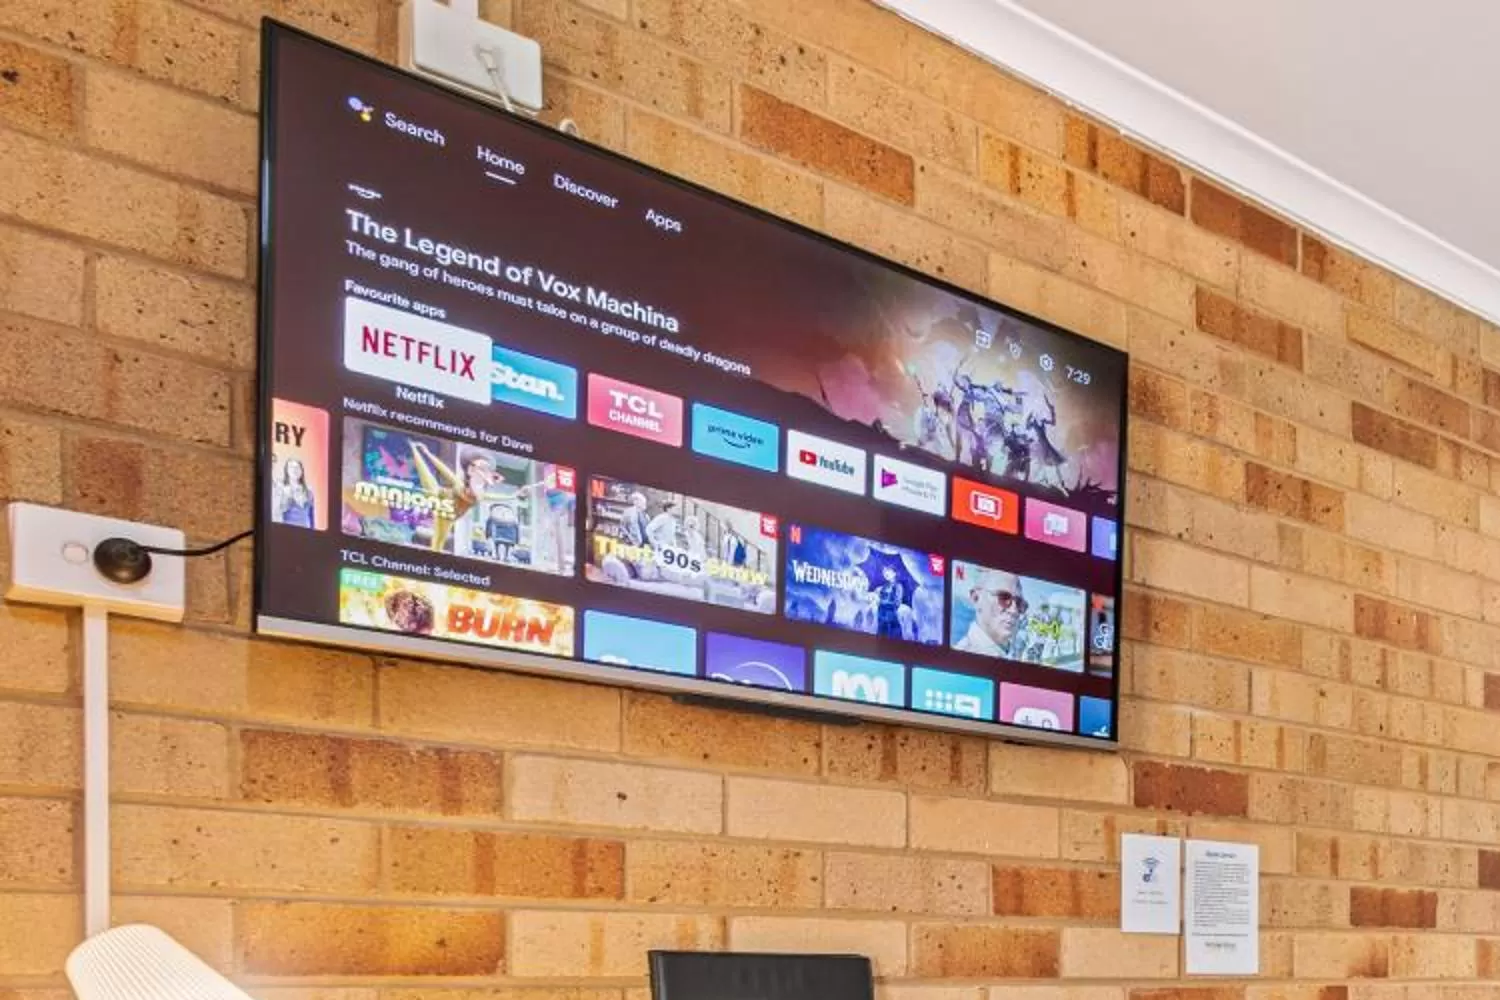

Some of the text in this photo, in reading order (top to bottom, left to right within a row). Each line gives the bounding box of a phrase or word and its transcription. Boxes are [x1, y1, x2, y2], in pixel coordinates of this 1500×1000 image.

[384, 111, 446, 147] Search
[476, 144, 525, 175] Home
[553, 172, 619, 208] Discover
[645, 208, 682, 233] Apps
[345, 208, 679, 333] The Legend of Vox Machina
[344, 279, 446, 319] Favourite apps
[345, 239, 752, 376] The gang of heroes must take on a group of deadly dragons
[361, 325, 476, 382] NETFLIX
[396, 385, 445, 409] Netflix
[608, 389, 664, 419] TCL
[343, 396, 534, 453] Netflix recommends for Dave
[608, 409, 663, 433] CHANNEL
[340, 549, 369, 565] TCL
[433, 566, 491, 586] Selected
[447, 603, 556, 645] BURN
